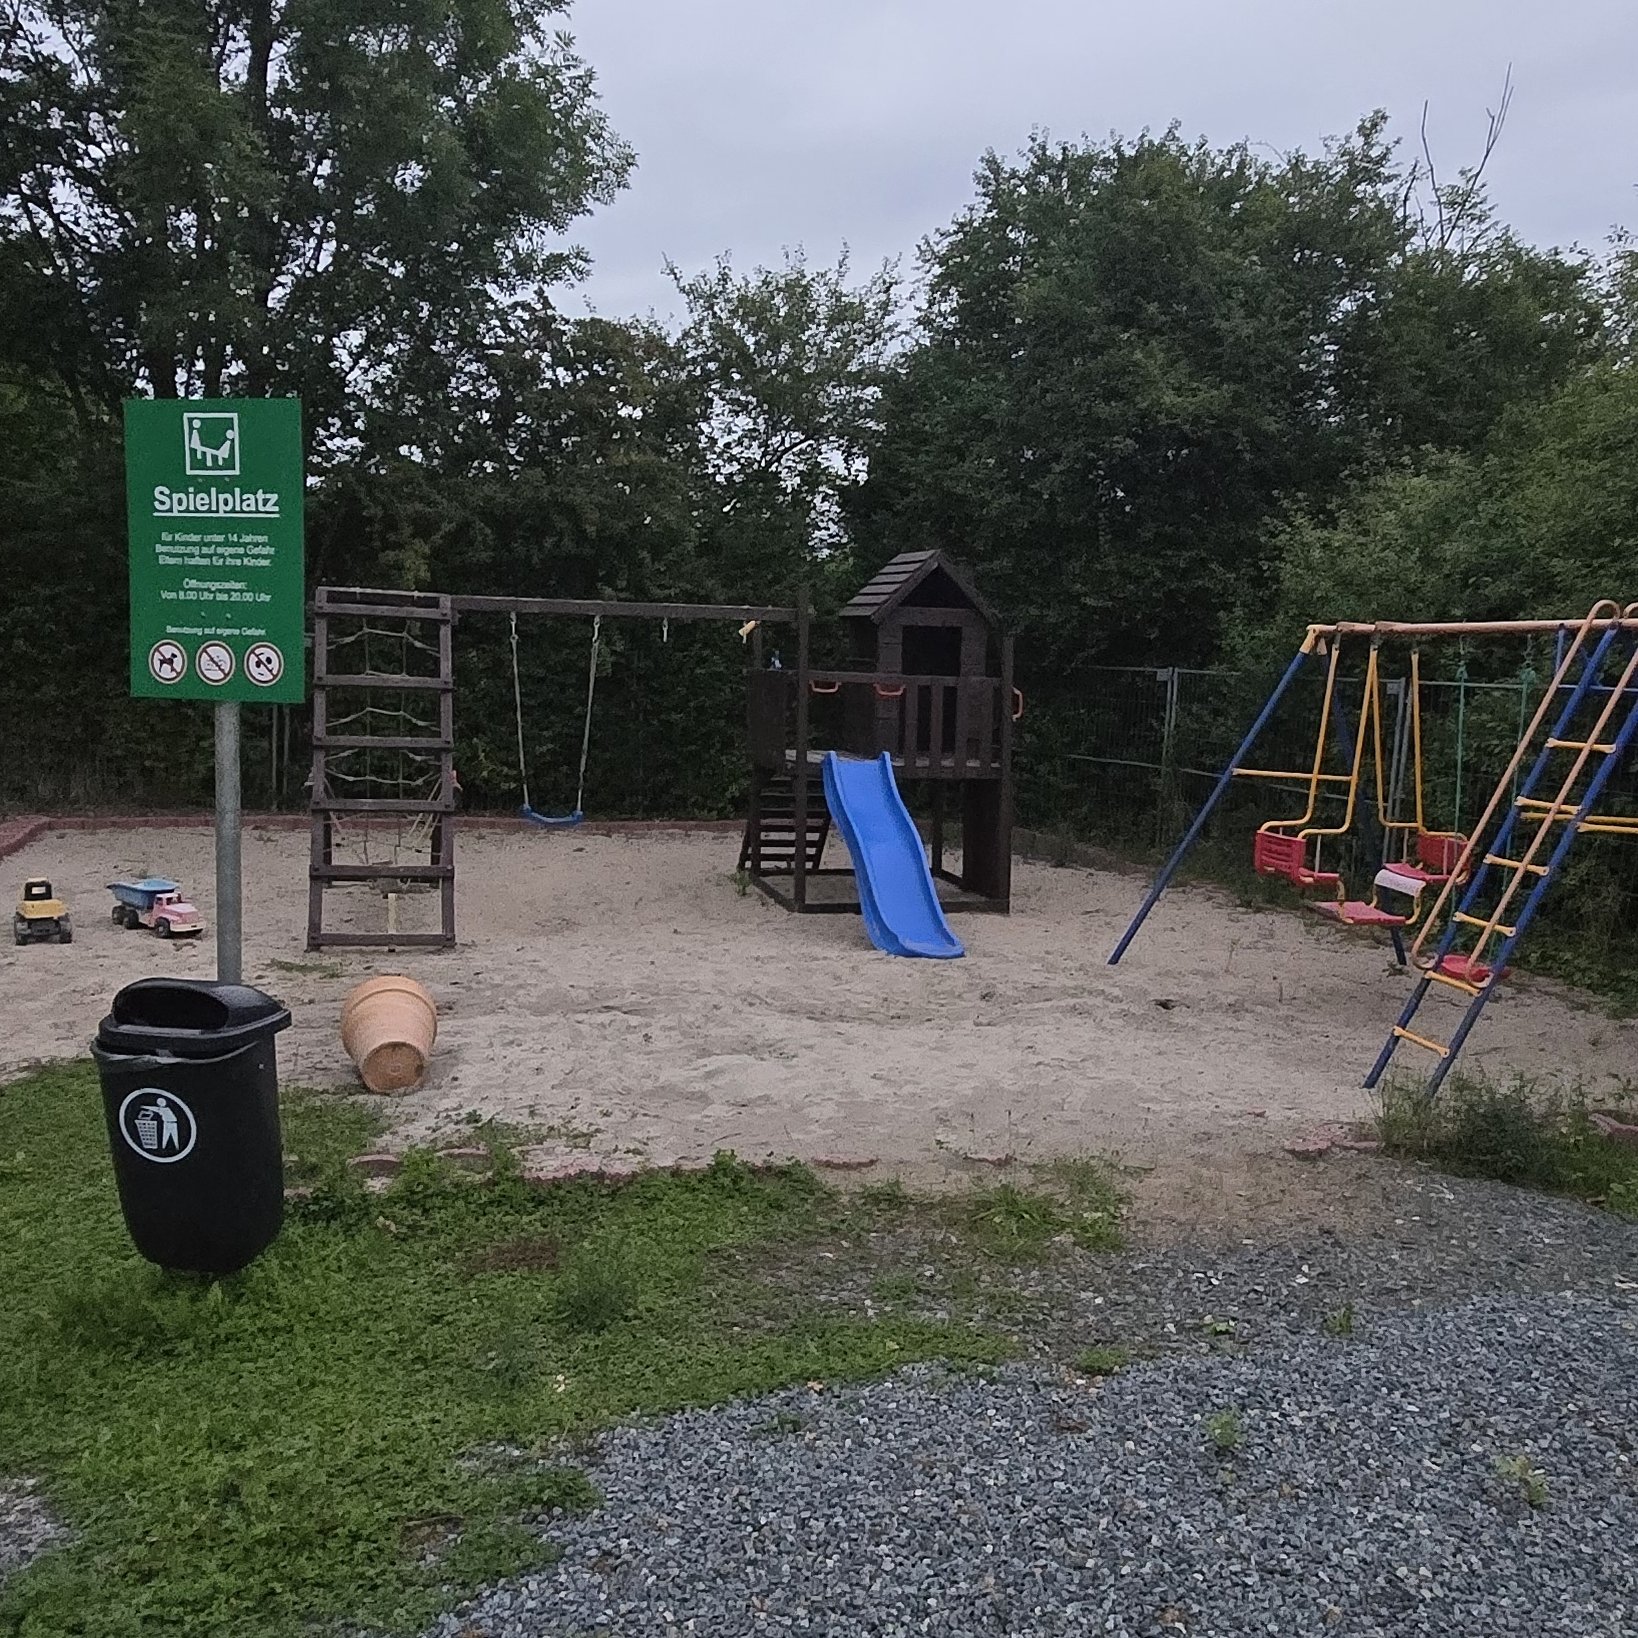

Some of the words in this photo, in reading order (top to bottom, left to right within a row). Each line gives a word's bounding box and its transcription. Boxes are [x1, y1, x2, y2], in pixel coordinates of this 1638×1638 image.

[153, 485, 279, 514] Spielplatz
[174, 532, 202, 542] Kinder
[203, 533, 226, 542] unter
[227, 533, 238, 542] 14
[239, 533, 269, 543] Jahren
[155, 543, 200, 555] Benutzung
[201, 544, 216, 554] auf
[216, 546, 245, 556] eigene
[160, 590, 178, 600] Von
[199, 591, 214, 601] Uhr
[215, 592, 229, 601] bis
[229, 592, 254, 602] 20.00
[255, 593, 272, 602] Uhr
[166, 625, 203, 636] Benutzung
[203, 626, 216, 635] auf
